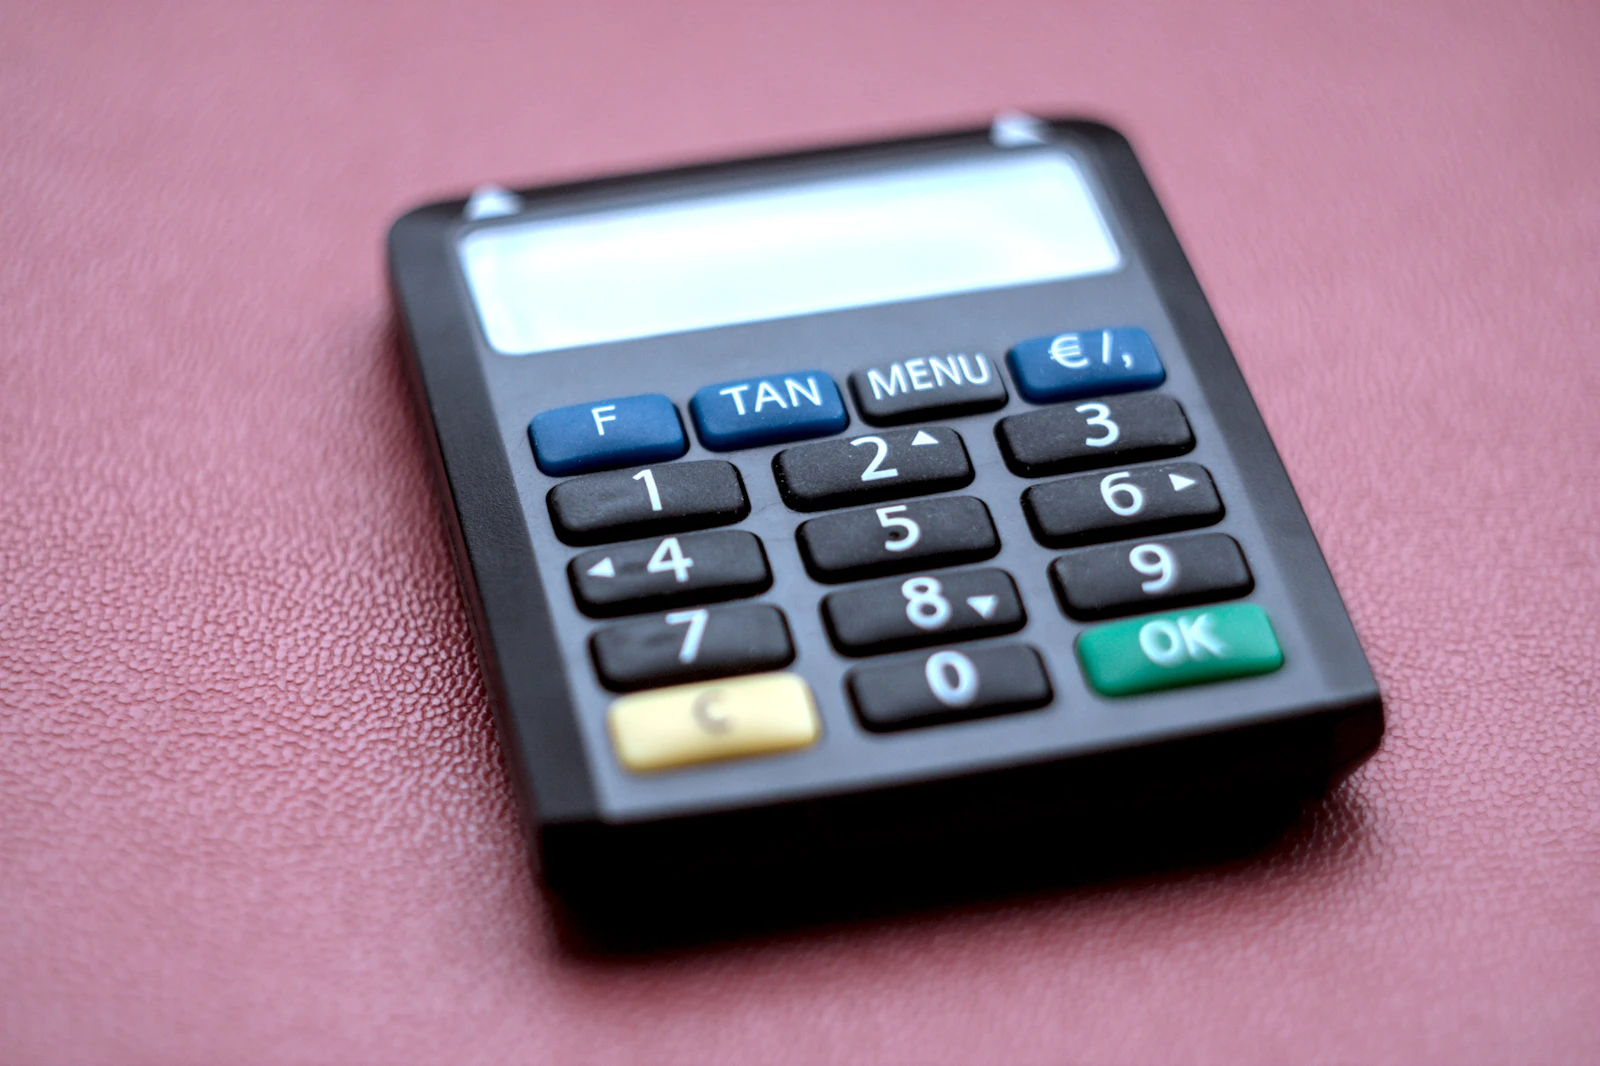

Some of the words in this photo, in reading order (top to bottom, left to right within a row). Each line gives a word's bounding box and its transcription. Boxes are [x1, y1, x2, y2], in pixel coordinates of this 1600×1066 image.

[719, 376, 823, 416] TAN
[866, 353, 992, 400] MENU
[591, 405, 616, 436] F
[1074, 403, 1120, 448] 3
[850, 435, 899, 482] 2
[632, 468, 663, 512] 1
[1100, 471, 1144, 517] 6
[875, 505, 921, 551] 5
[647, 537, 694, 582] 4
[1128, 543, 1177, 594] 9
[901, 576, 953, 630] 8
[665, 608, 710, 664] 7
[1137, 612, 1228, 668] OK
[692, 687, 735, 737] C
